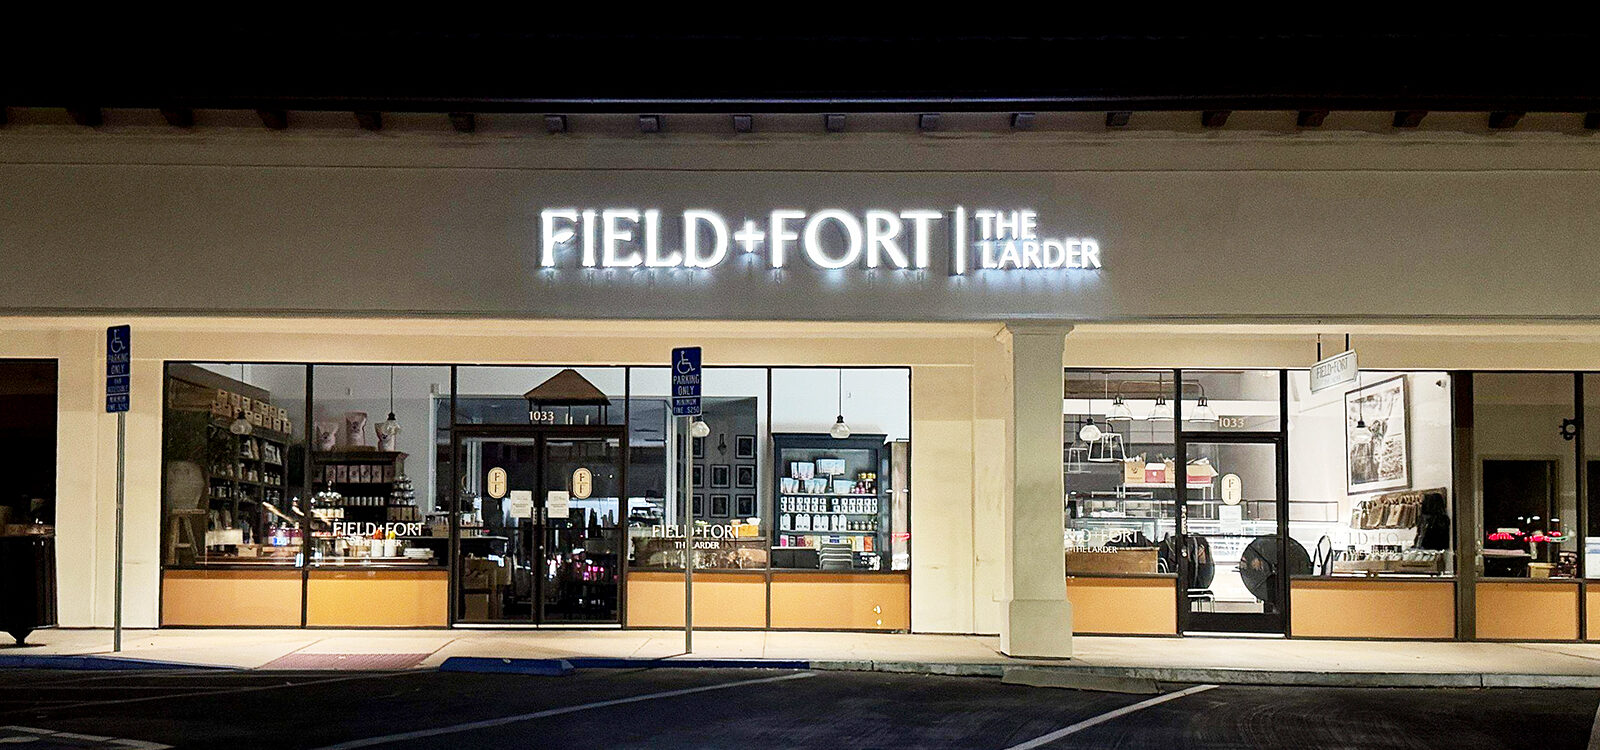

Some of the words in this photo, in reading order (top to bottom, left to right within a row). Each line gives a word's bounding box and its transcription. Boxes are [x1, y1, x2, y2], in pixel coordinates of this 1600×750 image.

[976, 211, 1037, 240] THE
[540, 208, 943, 270] FIELD+FORT
[980, 240, 1102, 270] LARDER
[111, 364, 125, 374] ONLY
[673, 375, 699, 384] PARKING
[678, 386, 694, 395] ONLY
[529, 410, 555, 421] 1033
[1218, 417, 1245, 428] 1033
[333, 521, 425, 536] FIELD+FORT
[674, 541, 689, 549] TH
[1087, 546, 1118, 554] LARDER
